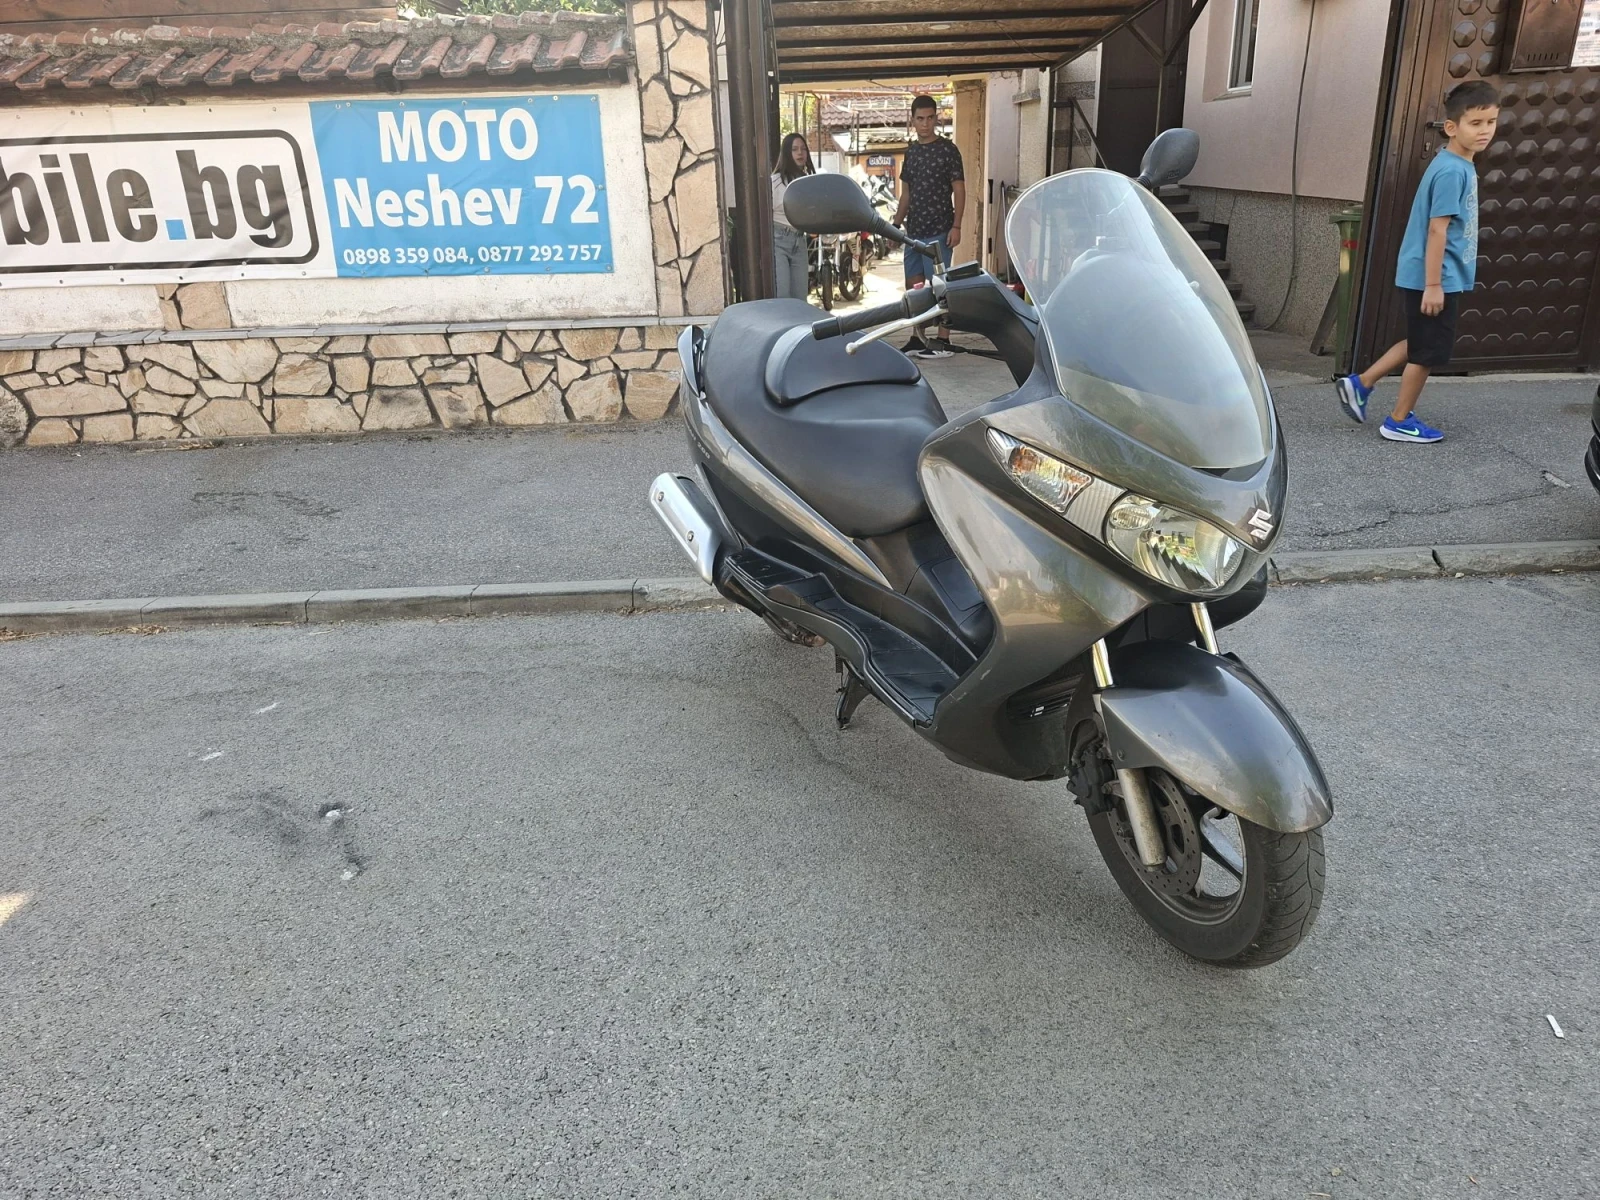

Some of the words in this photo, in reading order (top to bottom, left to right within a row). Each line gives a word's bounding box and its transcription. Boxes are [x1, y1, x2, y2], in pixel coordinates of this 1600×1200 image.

[378, 107, 538, 163] MOTO
[333, 173, 522, 228] Neshev
[534, 174, 599, 224] 72
[343, 248, 391, 265] 0898
[395, 247, 429, 264] 359
[433, 246, 474, 265] 084,
[478, 245, 523, 263] 0877
[529, 244, 564, 262] 292
[568, 244, 602, 261] 757
